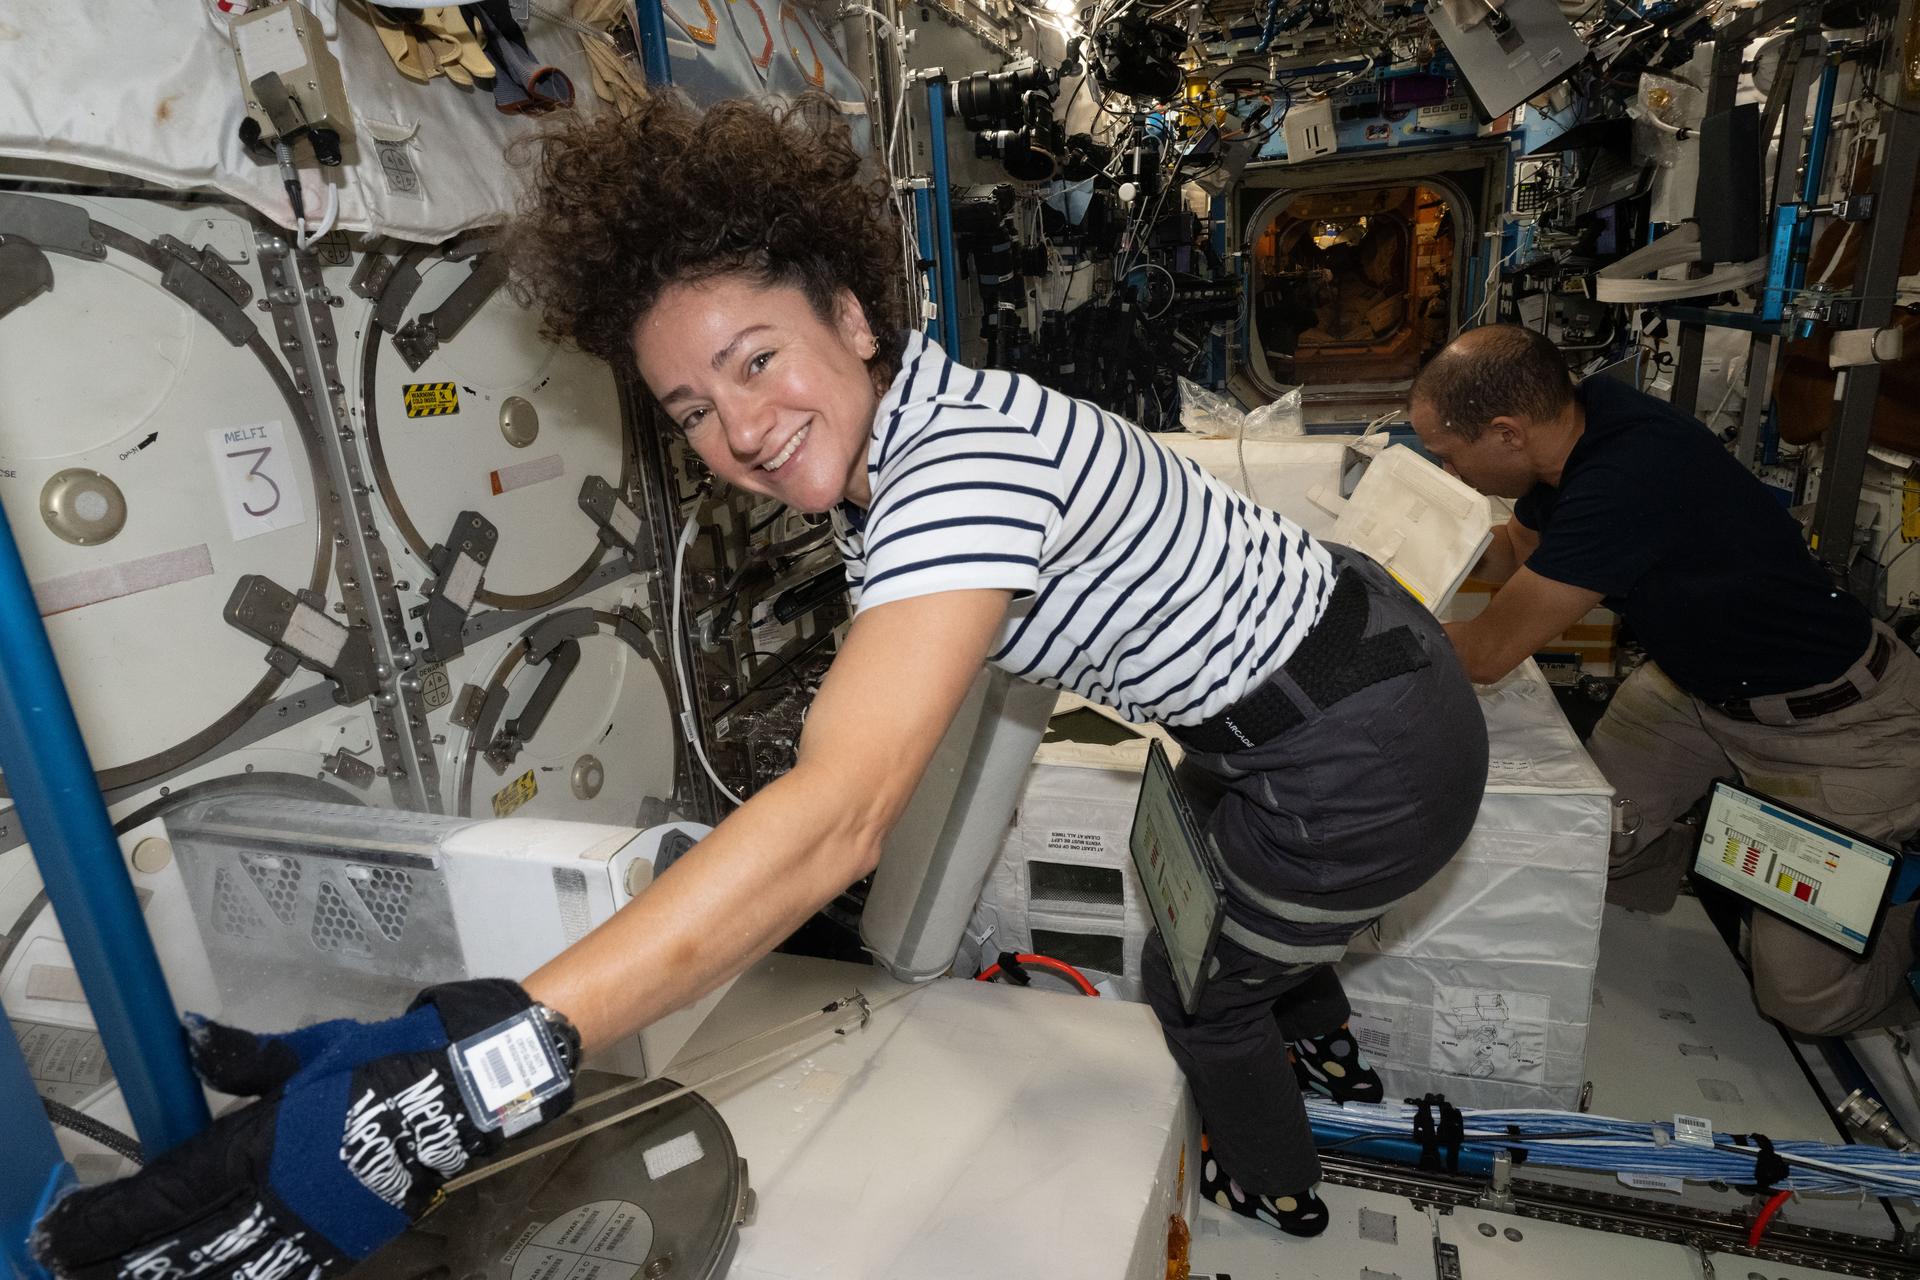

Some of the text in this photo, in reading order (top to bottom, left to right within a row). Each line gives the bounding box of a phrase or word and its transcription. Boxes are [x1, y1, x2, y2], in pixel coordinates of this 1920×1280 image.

[224, 426, 268, 444] MELFI
[226, 446, 281, 517] 3
[557, 1220, 580, 1245] DEWAR
[594, 1226, 616, 1252] DEWAR
[504, 1231, 532, 1262] DEWAR
